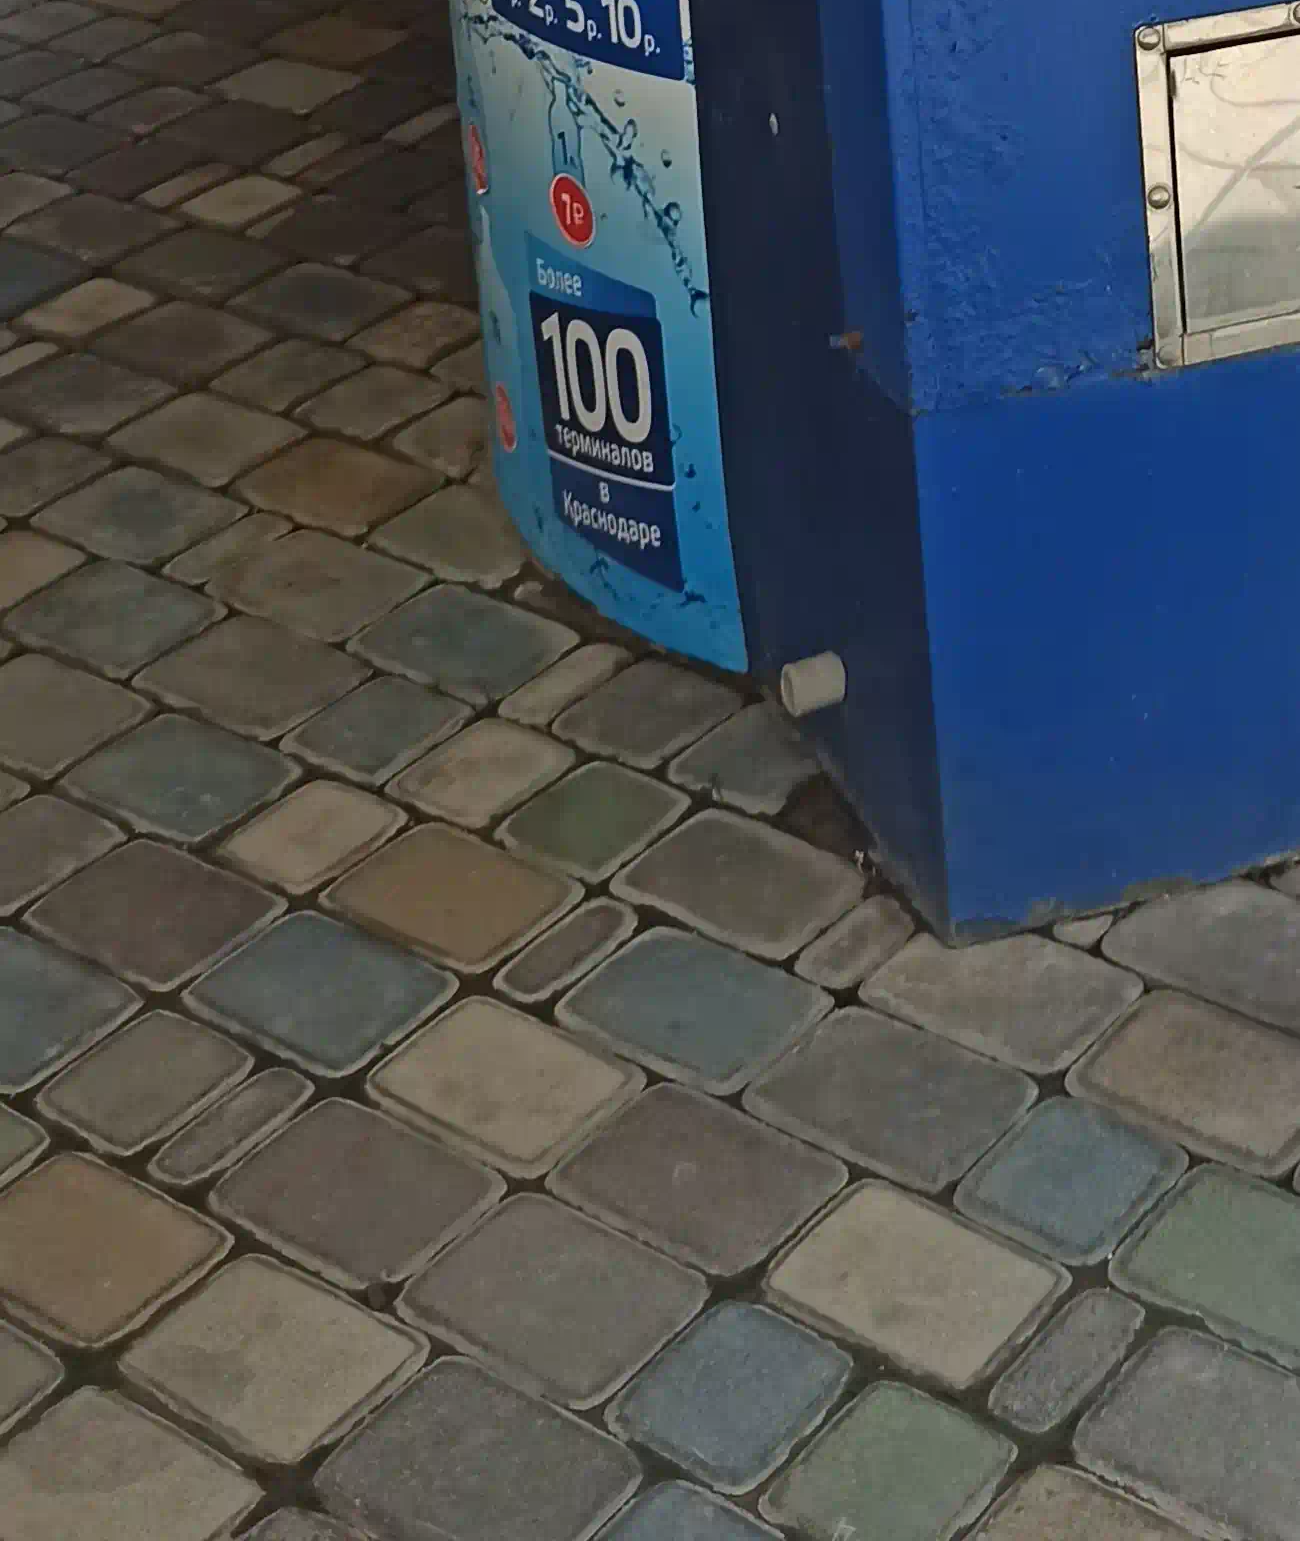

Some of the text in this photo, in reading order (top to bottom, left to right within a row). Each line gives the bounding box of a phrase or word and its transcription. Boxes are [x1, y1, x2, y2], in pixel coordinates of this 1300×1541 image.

[536, 257, 584, 297] Более
[540, 310, 653, 445] 100
[555, 421, 656, 475] терминалов
[563, 488, 662, 551] Краснодаре
